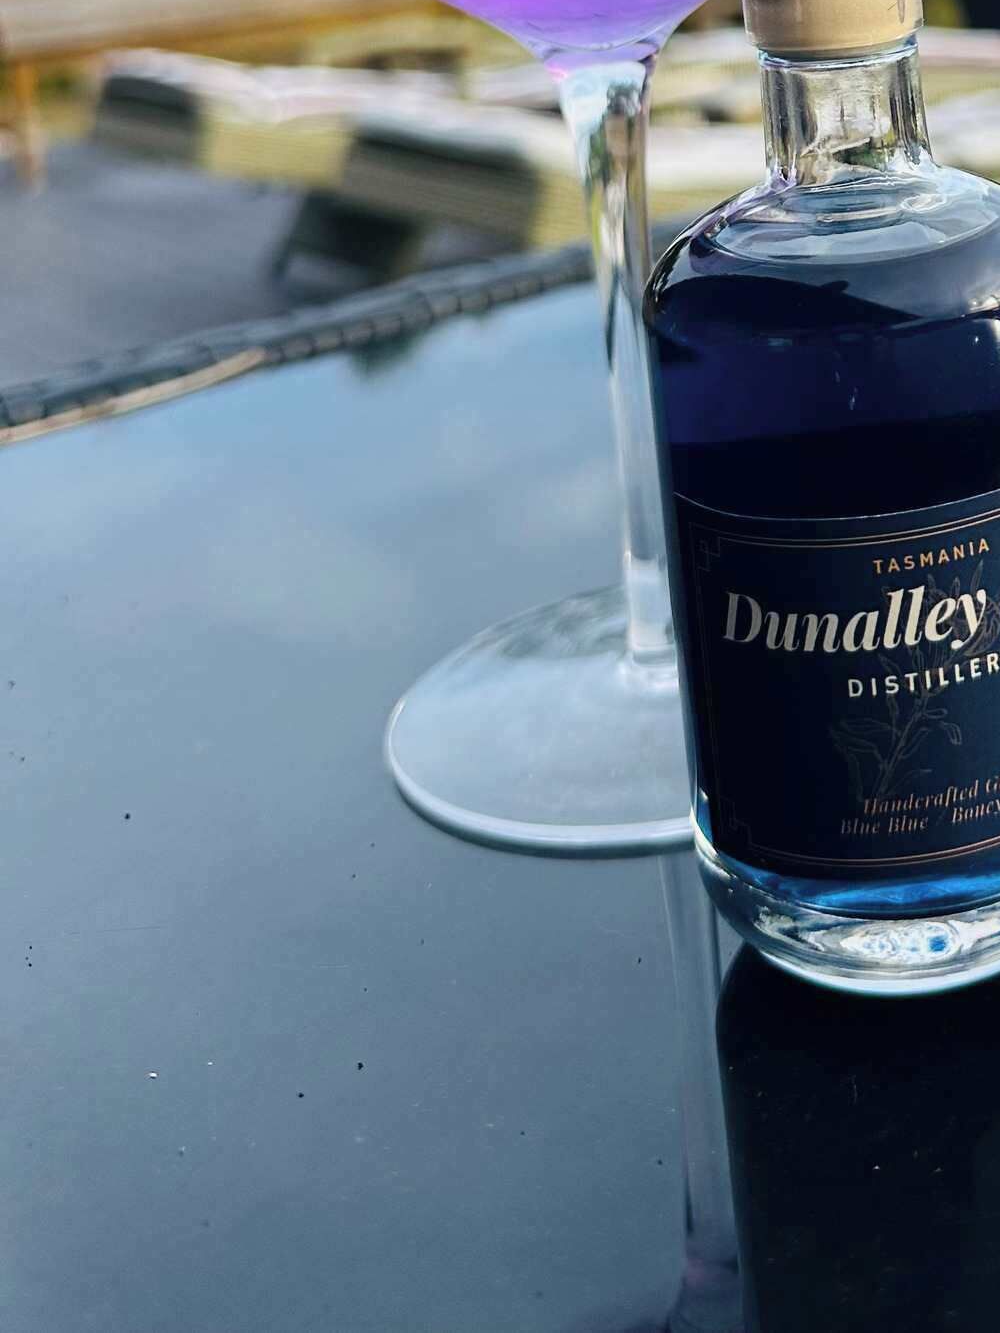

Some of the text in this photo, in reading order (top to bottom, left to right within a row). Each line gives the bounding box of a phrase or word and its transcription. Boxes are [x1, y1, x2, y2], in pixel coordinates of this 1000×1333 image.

[872, 538, 990, 575] TASMANIA
[722, 585, 991, 653] Dunalley
[863, 779, 979, 815] Handcrafted
[840, 818, 881, 835] Blue
[888, 815, 929, 834] Blue
